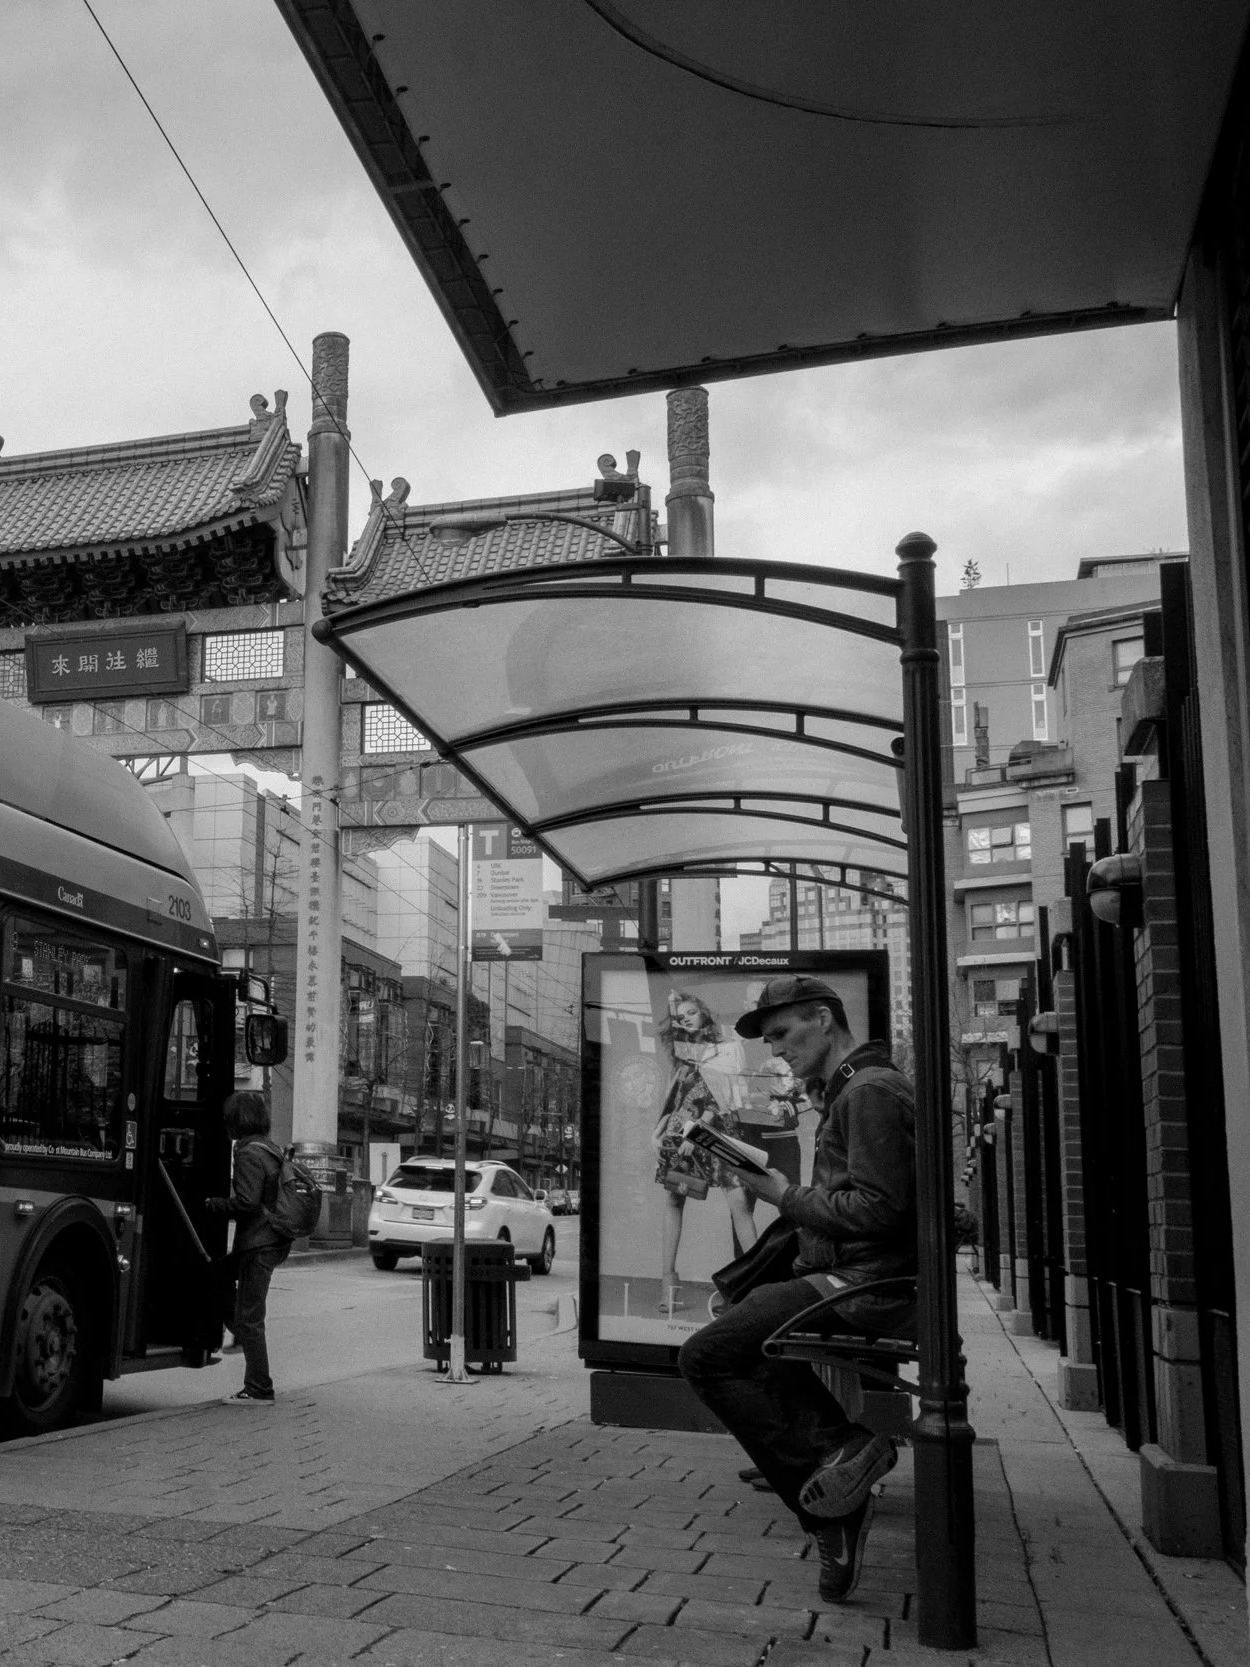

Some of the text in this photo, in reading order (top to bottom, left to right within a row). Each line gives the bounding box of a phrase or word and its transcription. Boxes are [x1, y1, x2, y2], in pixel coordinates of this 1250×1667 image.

[511, 845, 536, 855] 50091
[58, 886, 83, 908] Canada
[169, 895, 191, 921] 2103
[670, 956, 733, 966] OUTFRONT
[738, 956, 790, 966] JCDecaux
[5, 1142, 22, 1154] proudly
[23, 1144, 42, 1155] operated
[48, 1145, 60, 1155] Cost
[60, 1146, 80, 1156] Mountain
[88, 1148, 105, 1160] Company
